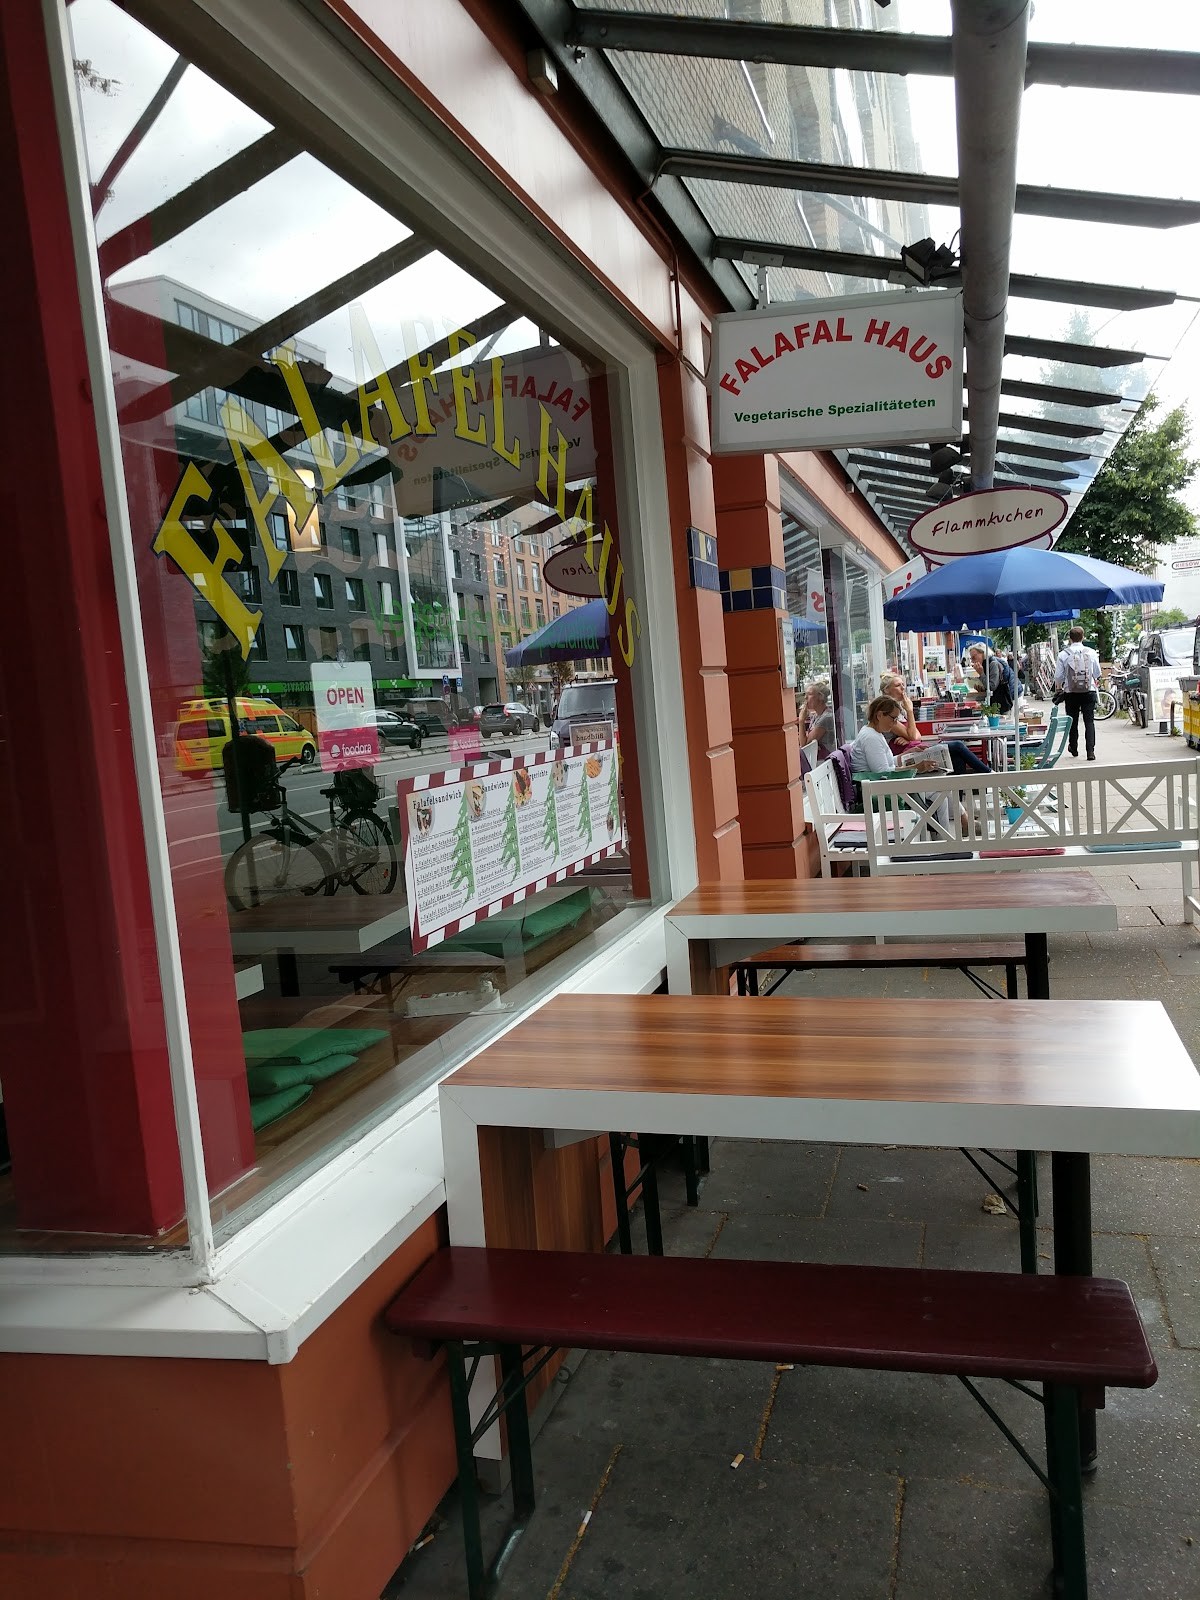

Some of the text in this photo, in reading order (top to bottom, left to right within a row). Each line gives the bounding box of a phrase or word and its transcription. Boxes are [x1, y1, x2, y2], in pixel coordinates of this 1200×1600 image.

[719, 317, 952, 396] FALAFAL HAUS
[734, 398, 936, 424] Vegetarische Spezialitäteten
[151, 302, 642, 668] FALAFEL HAUS
[931, 507, 1044, 537] Flammkuchen
[326, 686, 365, 706] OPEN
[341, 742, 372, 756] foodora
[412, 790, 462, 810] Falafelsandwich
